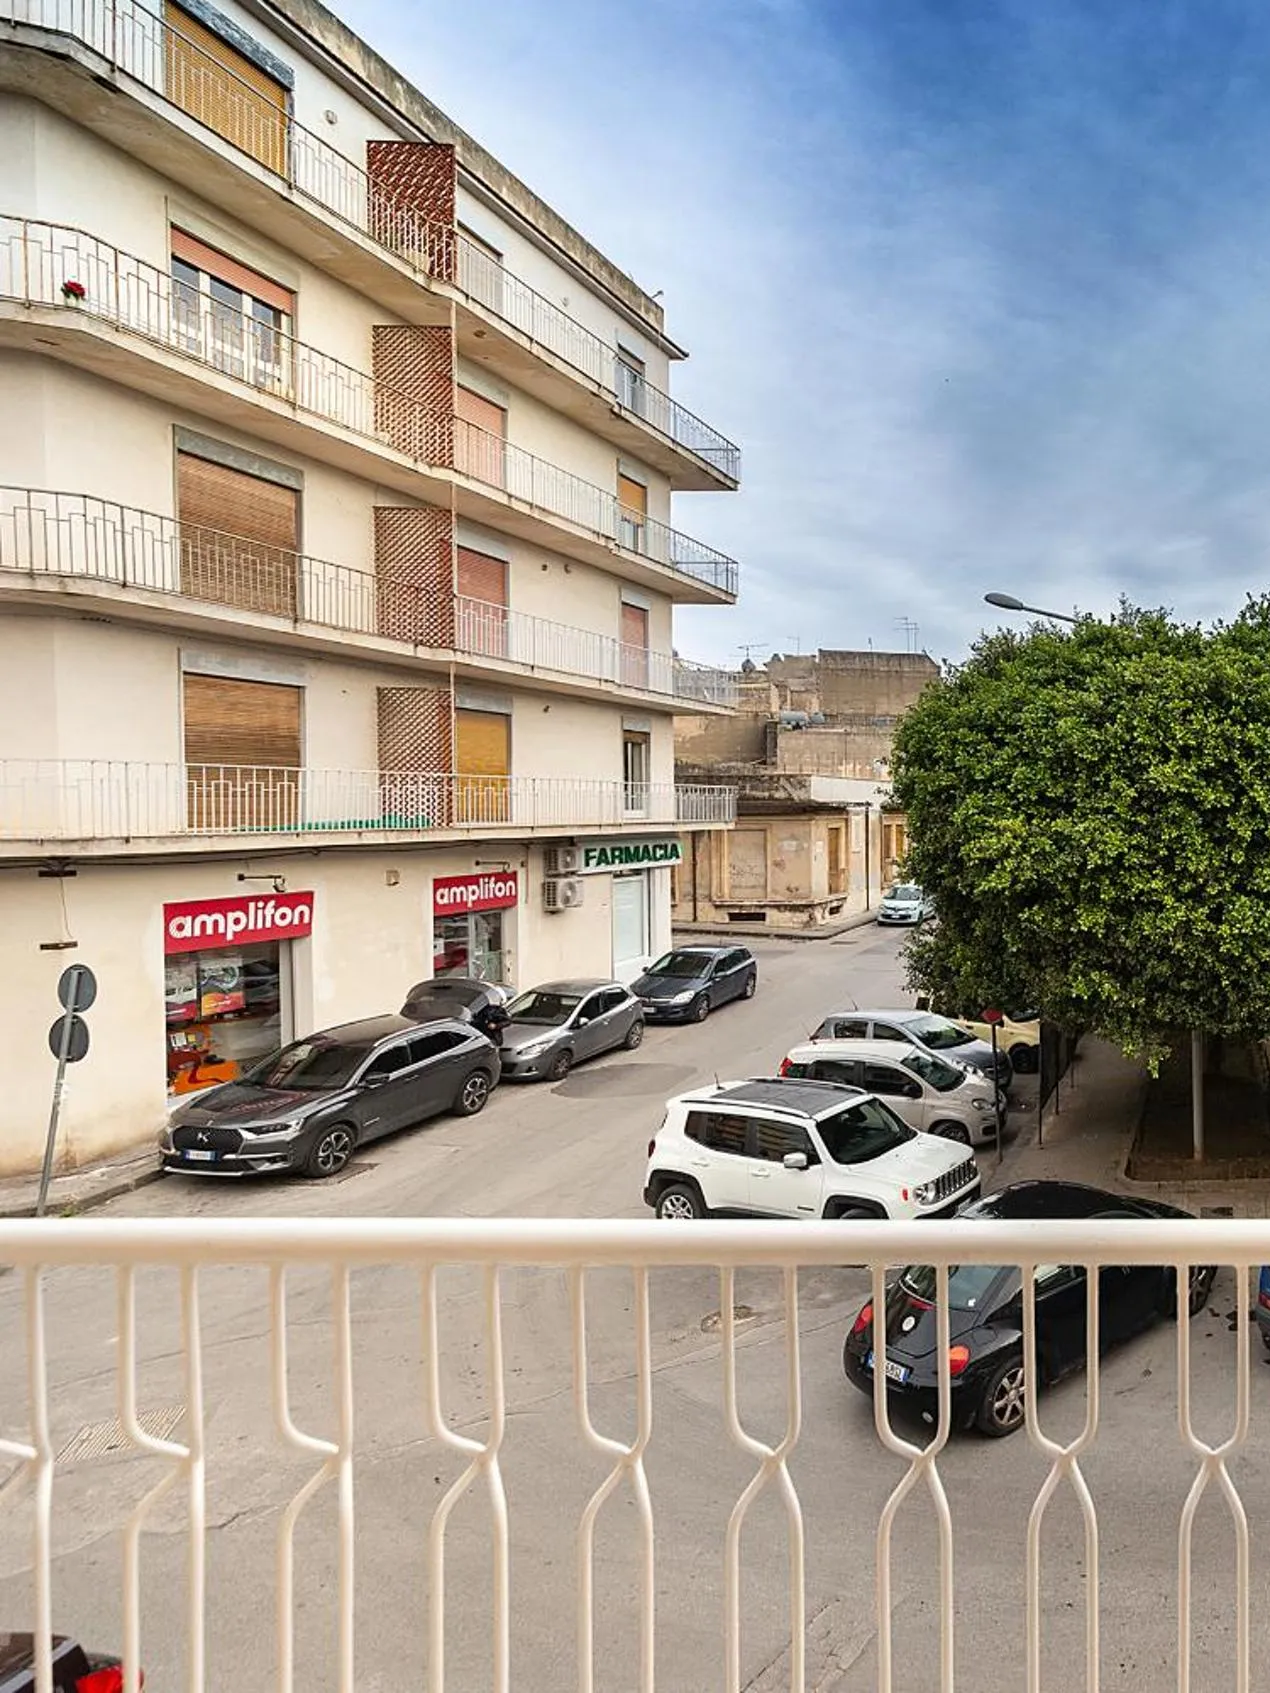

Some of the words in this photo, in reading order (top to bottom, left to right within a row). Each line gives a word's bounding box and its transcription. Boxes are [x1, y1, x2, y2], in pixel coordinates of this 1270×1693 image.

[584, 843, 681, 867] FARMACIA
[436, 877, 516, 908] amplifon
[168, 900, 311, 941] amplifon
